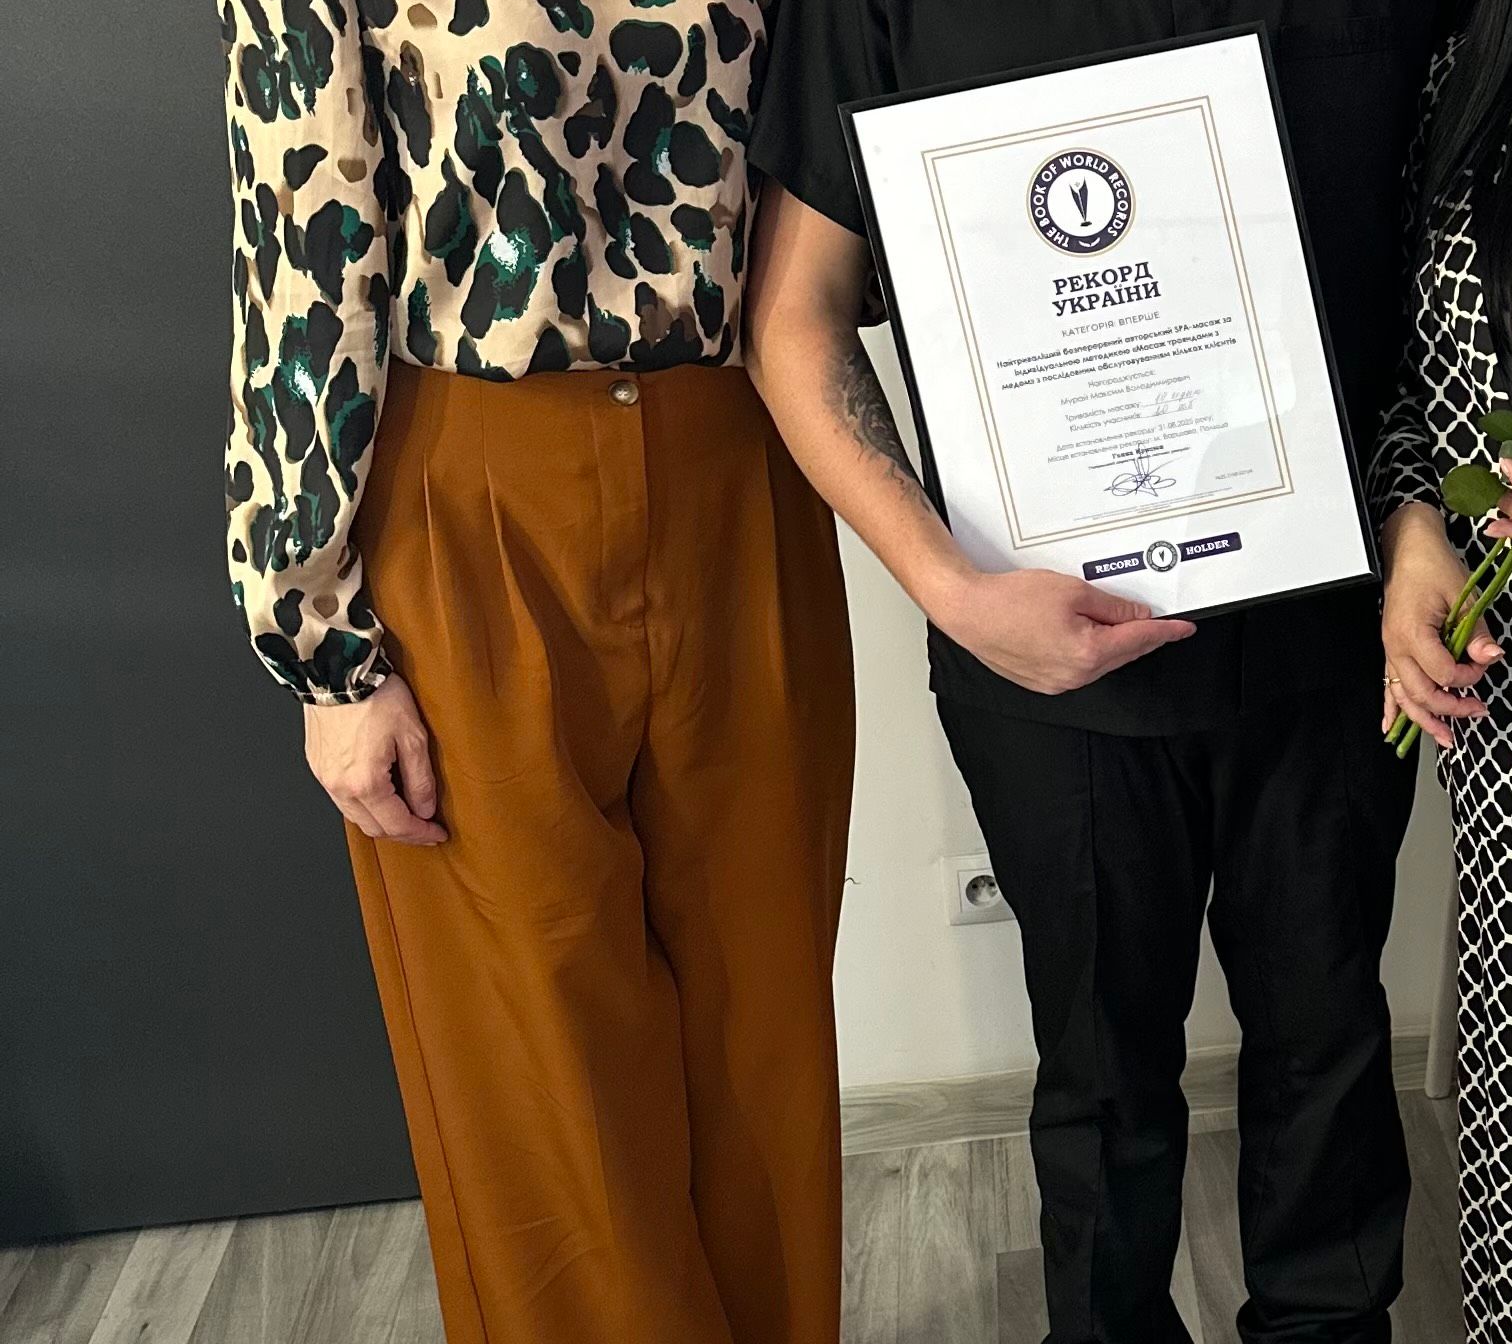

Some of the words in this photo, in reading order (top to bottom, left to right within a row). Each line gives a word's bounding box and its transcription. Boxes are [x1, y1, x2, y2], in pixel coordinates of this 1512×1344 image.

[1042, 163, 1057, 182] OF
[1059, 155, 1108, 173] WORLD
[1033, 184, 1050, 227] BOOK
[1107, 172, 1128, 237] RECORDS
[1046, 227, 1069, 247] THE
[1053, 261, 1153, 295] РЕКОРД
[1052, 281, 1161, 316] УКРАЇНИ
[1118, 311, 1160, 325] ВПЕРШЕ
[1095, 558, 1139, 574] RECORD
[1186, 539, 1230, 555] HOLDER
